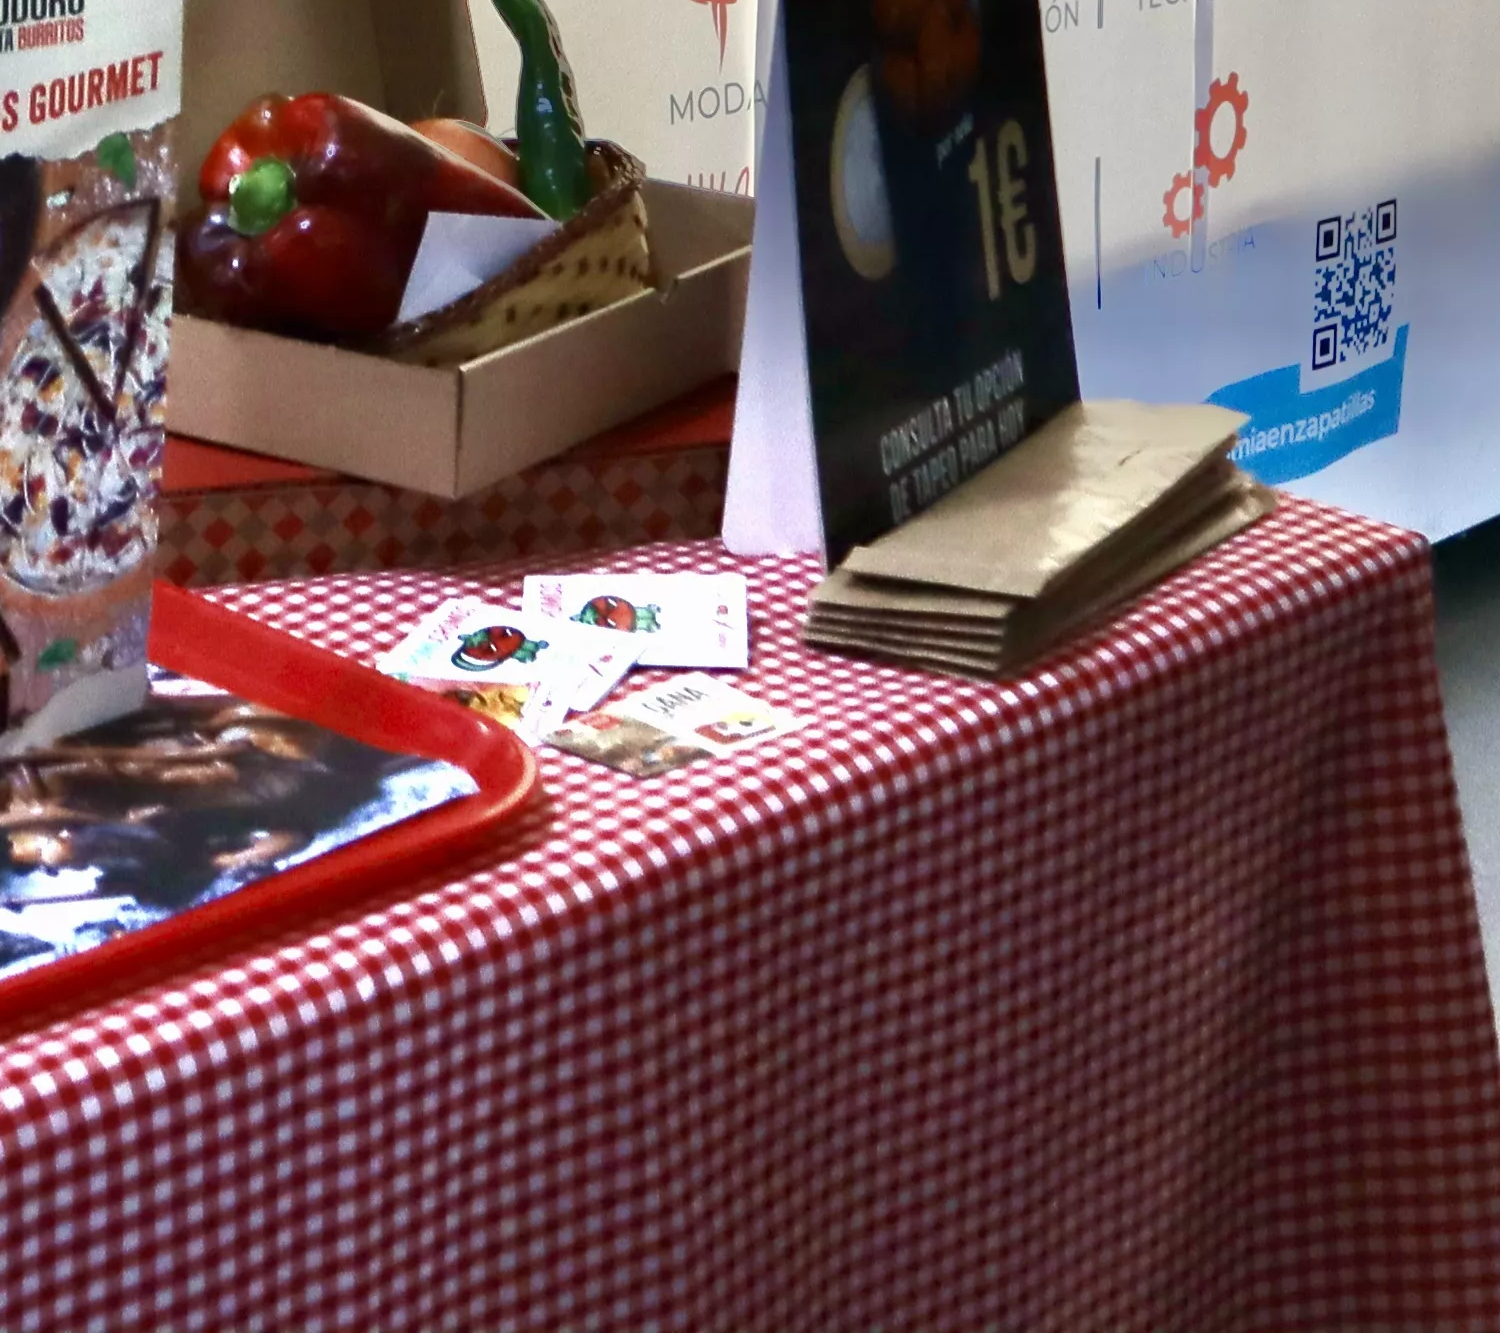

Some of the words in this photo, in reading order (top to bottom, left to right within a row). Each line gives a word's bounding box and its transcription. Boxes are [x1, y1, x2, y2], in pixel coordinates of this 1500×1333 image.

[17, 18, 85, 51] BURRITOS
[28, 51, 164, 126] GOURMET
[669, 79, 768, 126] MODA
[967, 119, 1037, 302] 1€
